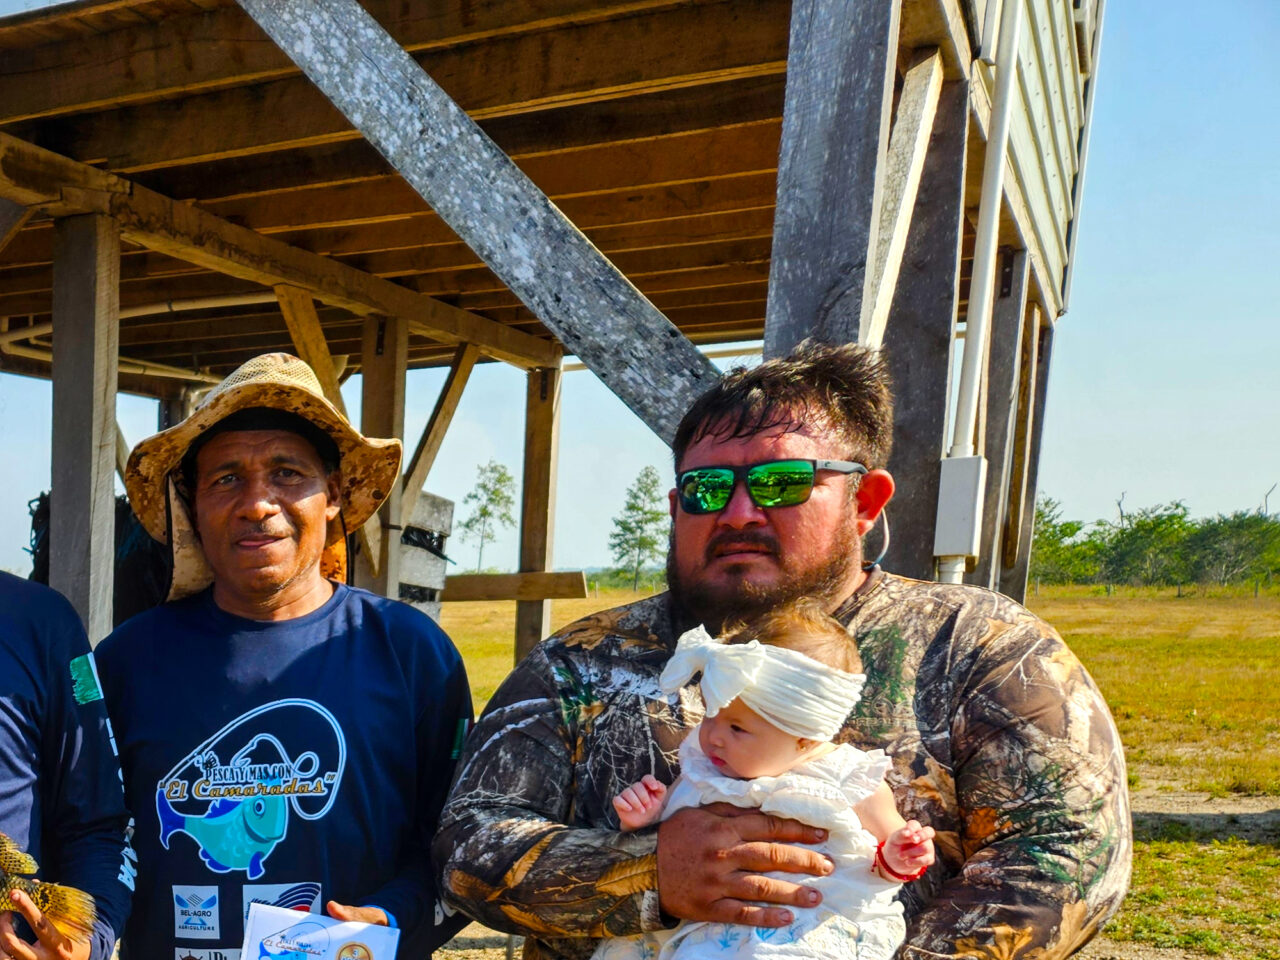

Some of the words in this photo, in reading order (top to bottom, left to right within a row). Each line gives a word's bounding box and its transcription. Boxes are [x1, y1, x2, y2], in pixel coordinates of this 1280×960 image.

[204, 767, 235, 782] PESCA
[237, 767, 246, 781] Y
[249, 766, 269, 781] MAS
[271, 765, 293, 780] CON
[180, 909, 212, 918] BEL-AGRO
[178, 923, 216, 931] AGRICULTURE
